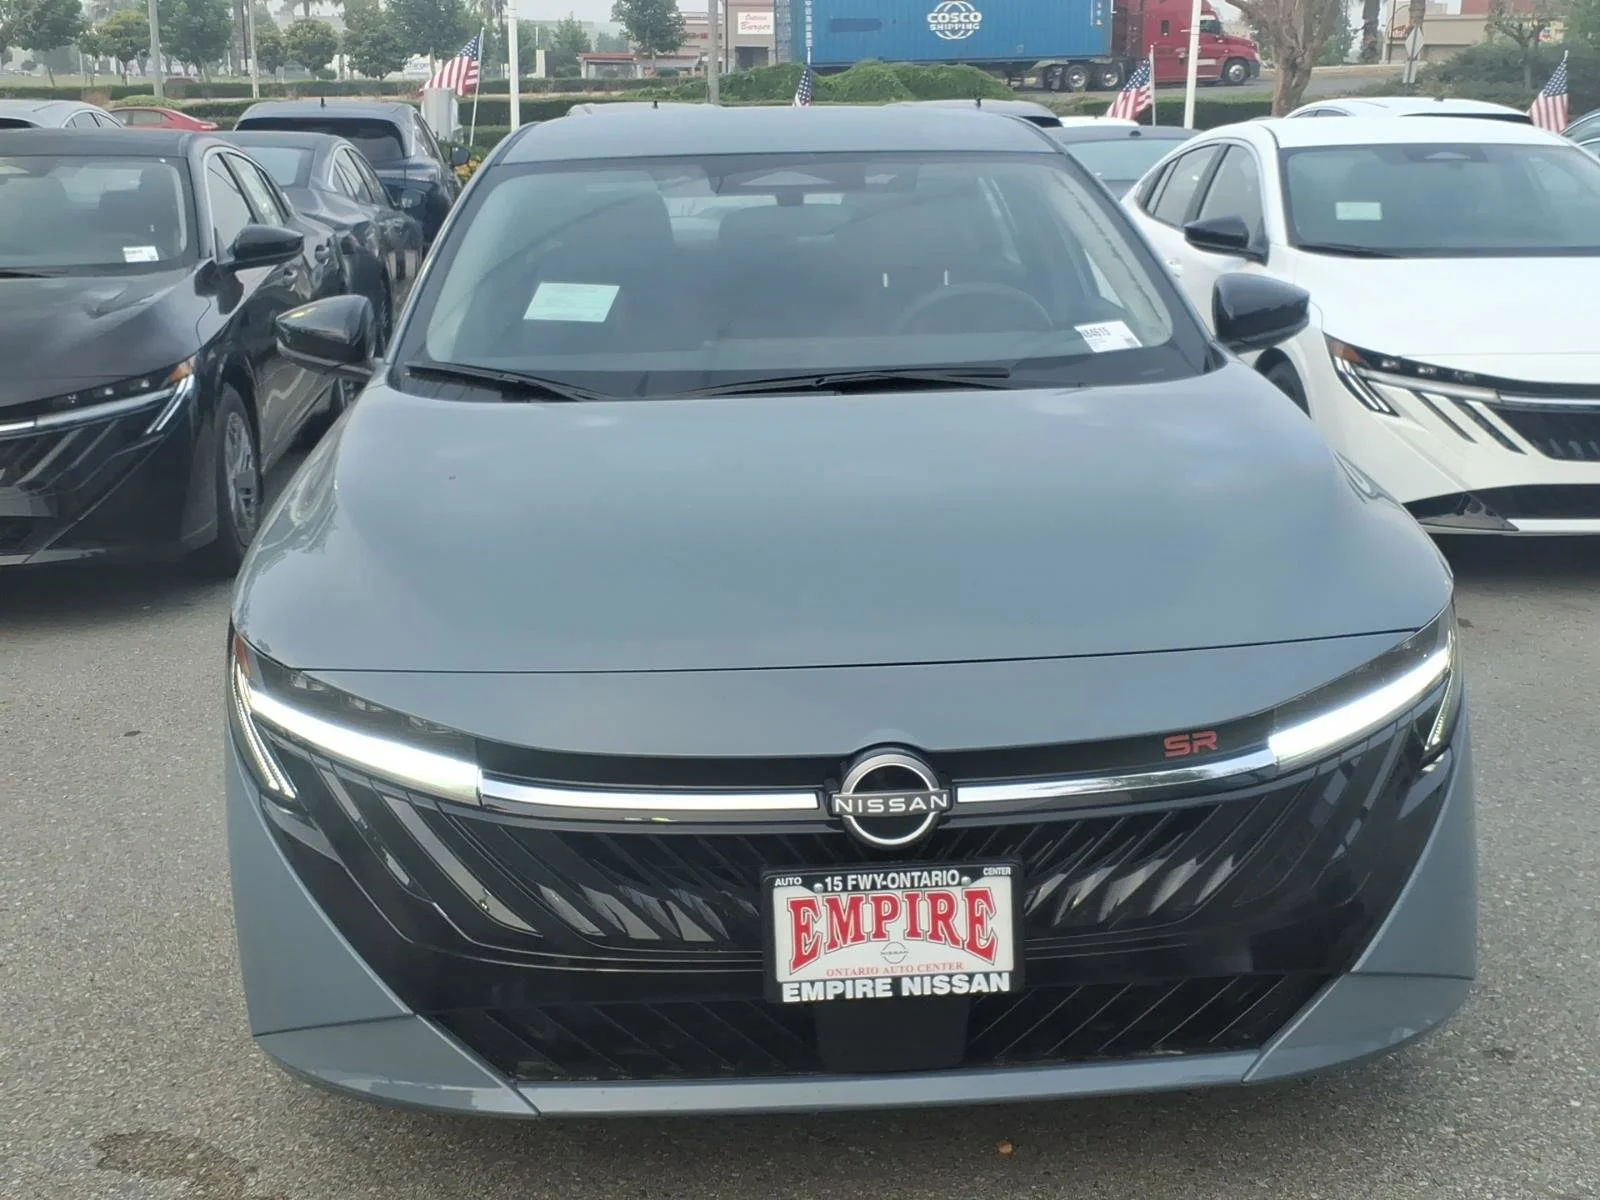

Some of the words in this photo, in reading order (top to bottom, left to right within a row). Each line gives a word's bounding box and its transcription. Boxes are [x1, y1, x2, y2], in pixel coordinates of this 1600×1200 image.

[927, 12, 982, 23] COSCO
[929, 23, 980, 31] SHIPPING
[1163, 731, 1218, 757] SR
[835, 793, 947, 813] NISSAN
[983, 867, 1011, 876] CENTER
[775, 877, 802, 887] AUTO
[825, 876, 843, 891] 15
[787, 887, 998, 975] EMPIRE
[826, 966, 879, 977] ONTARIO
[883, 965, 914, 974] AUTO
[917, 961, 964, 972] CENTER
[782, 978, 893, 1003] EMPIRE
[902, 972, 1010, 997] NISSAN
